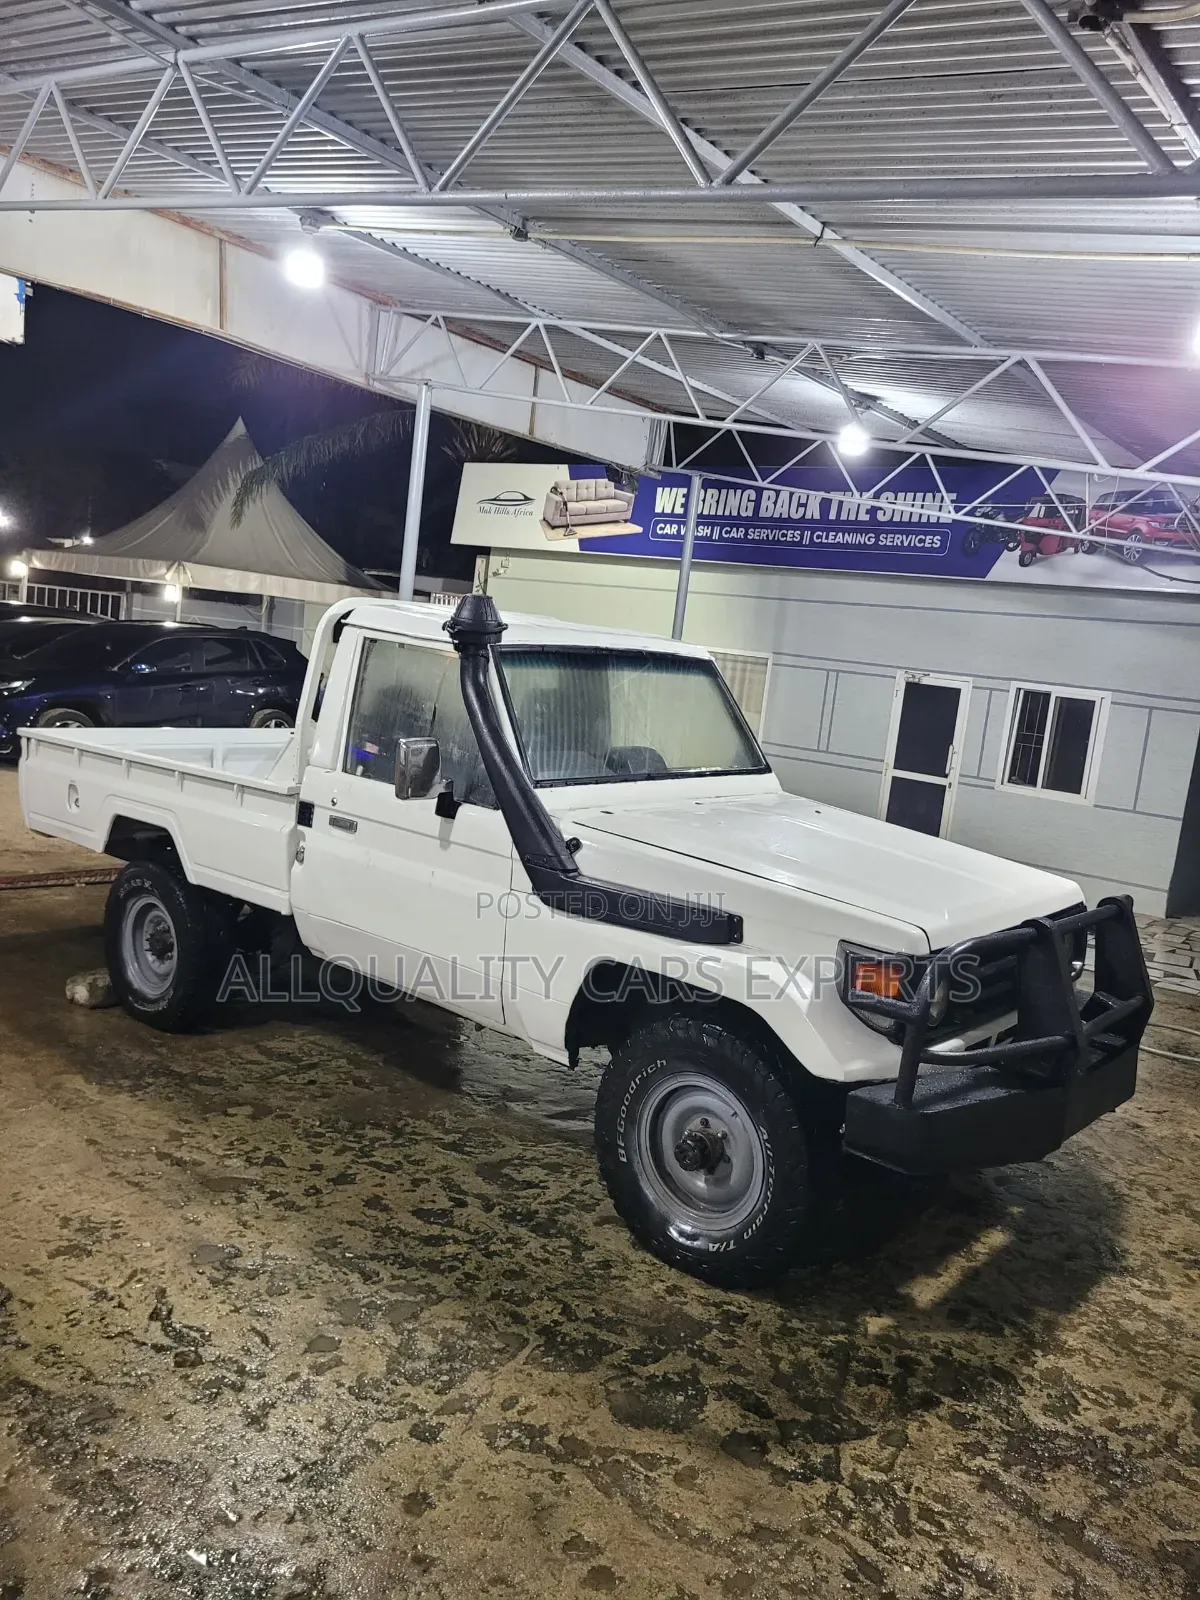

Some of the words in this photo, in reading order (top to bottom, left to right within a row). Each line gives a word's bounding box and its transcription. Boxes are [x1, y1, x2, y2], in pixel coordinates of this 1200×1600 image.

[493, 506, 510, 515] Hills
[511, 508, 534, 518] Africa
[654, 487, 688, 514] WE
[759, 489, 826, 520] BACK
[828, 491, 875, 521] THE
[876, 491, 957, 524] SHINE
[656, 523, 678, 535] CAR
[722, 526, 745, 539] CAR
[747, 528, 801, 542] SERVICES
[813, 531, 876, 545] CLEANING
[878, 533, 942, 548] SERVICES
[616, 1058, 668, 1164] BFGoodrich
[743, 1124, 776, 1240] All-Terrain
